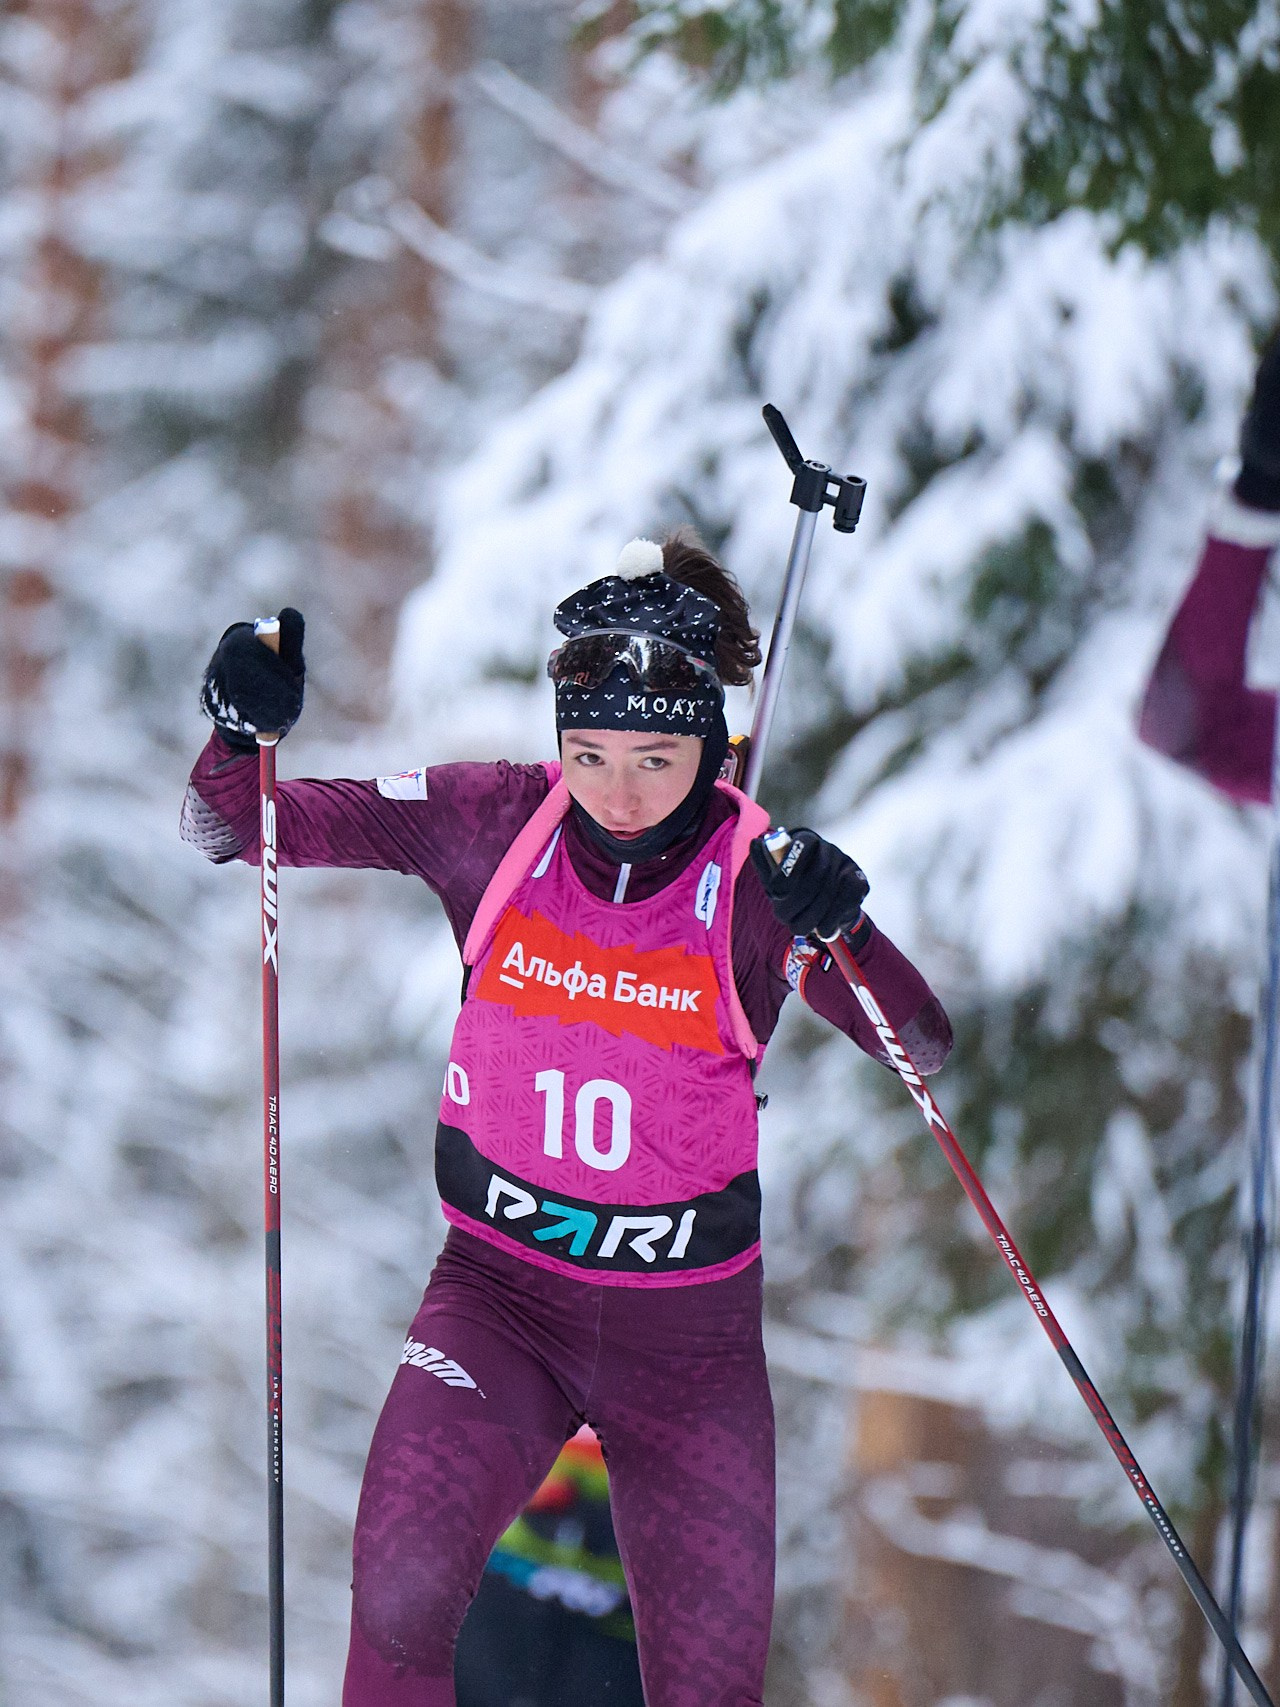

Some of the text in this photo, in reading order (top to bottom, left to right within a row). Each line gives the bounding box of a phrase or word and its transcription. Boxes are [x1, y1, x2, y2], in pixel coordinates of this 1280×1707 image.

[627, 696, 697, 716] MOAX
[262, 793, 277, 976] SWIX
[500, 941, 702, 1012] Альфа Банк
[442, 1061, 470, 1106] 0
[850, 982, 949, 1133] SWIX
[268, 1095, 277, 1135] TRIAC
[534, 1068, 632, 1171] 10
[269, 1156, 278, 1194] AERO
[484, 1173, 697, 1263] PARI
[996, 1233, 1021, 1268] TRIAC
[1024, 1285, 1048, 1318] AERO
